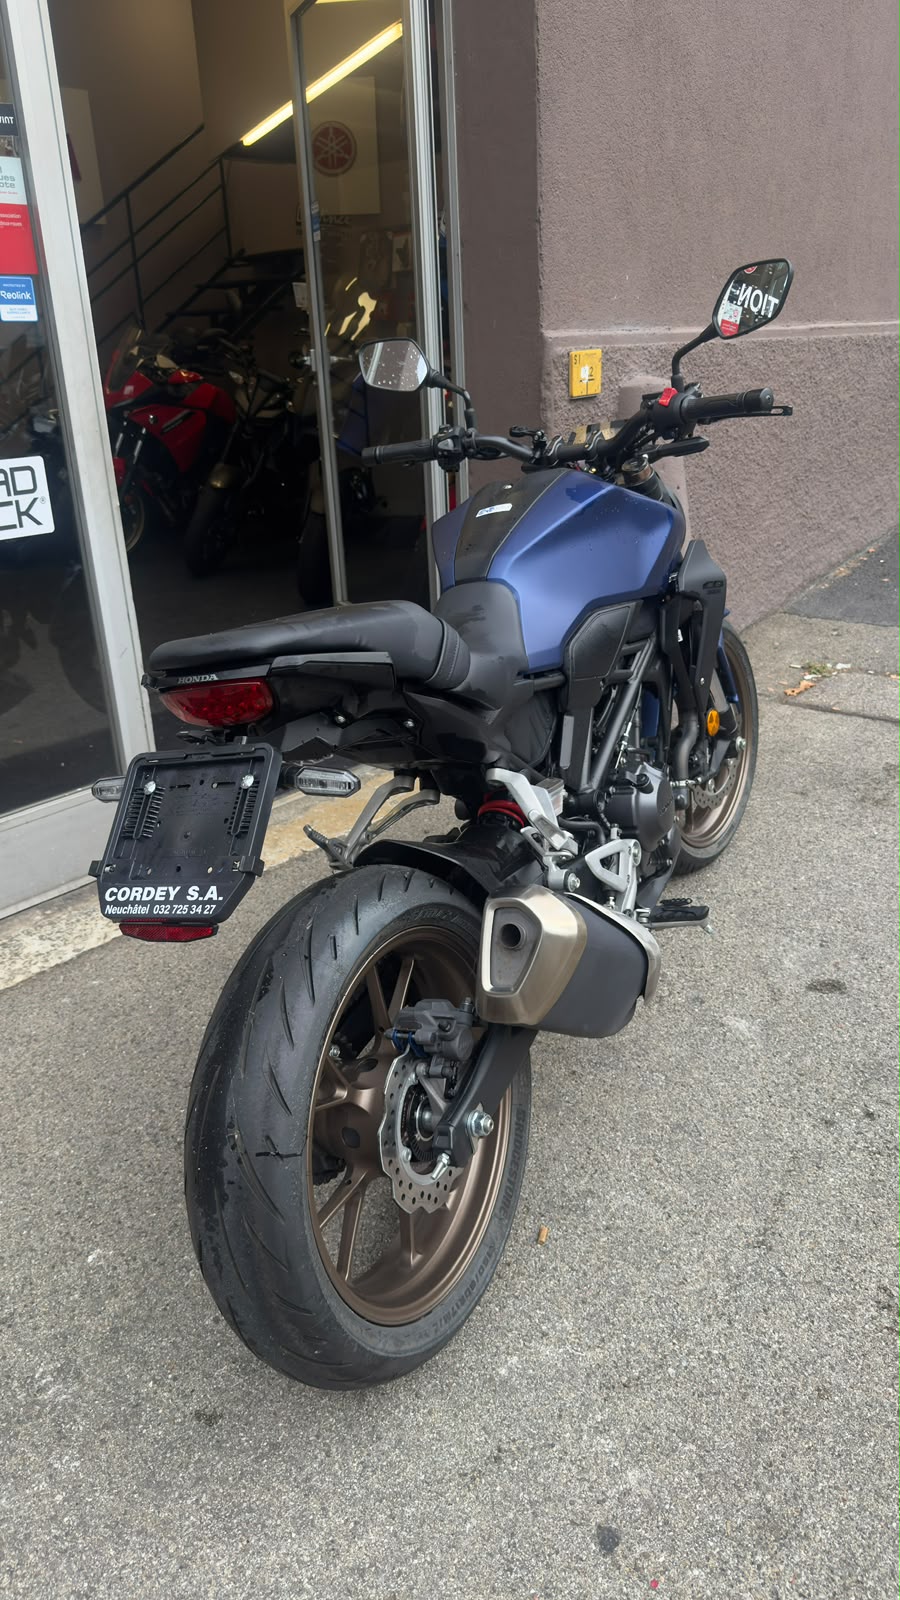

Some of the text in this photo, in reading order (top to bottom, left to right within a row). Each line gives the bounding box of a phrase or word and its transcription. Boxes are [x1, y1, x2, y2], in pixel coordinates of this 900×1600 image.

[0, 290, 32, 300] Reolink
[177, 673, 219, 685] HONDA
[105, 885, 223, 901] CORDEY S.A.
[105, 904, 216, 914] Neuchâtel 032 725 34 27
